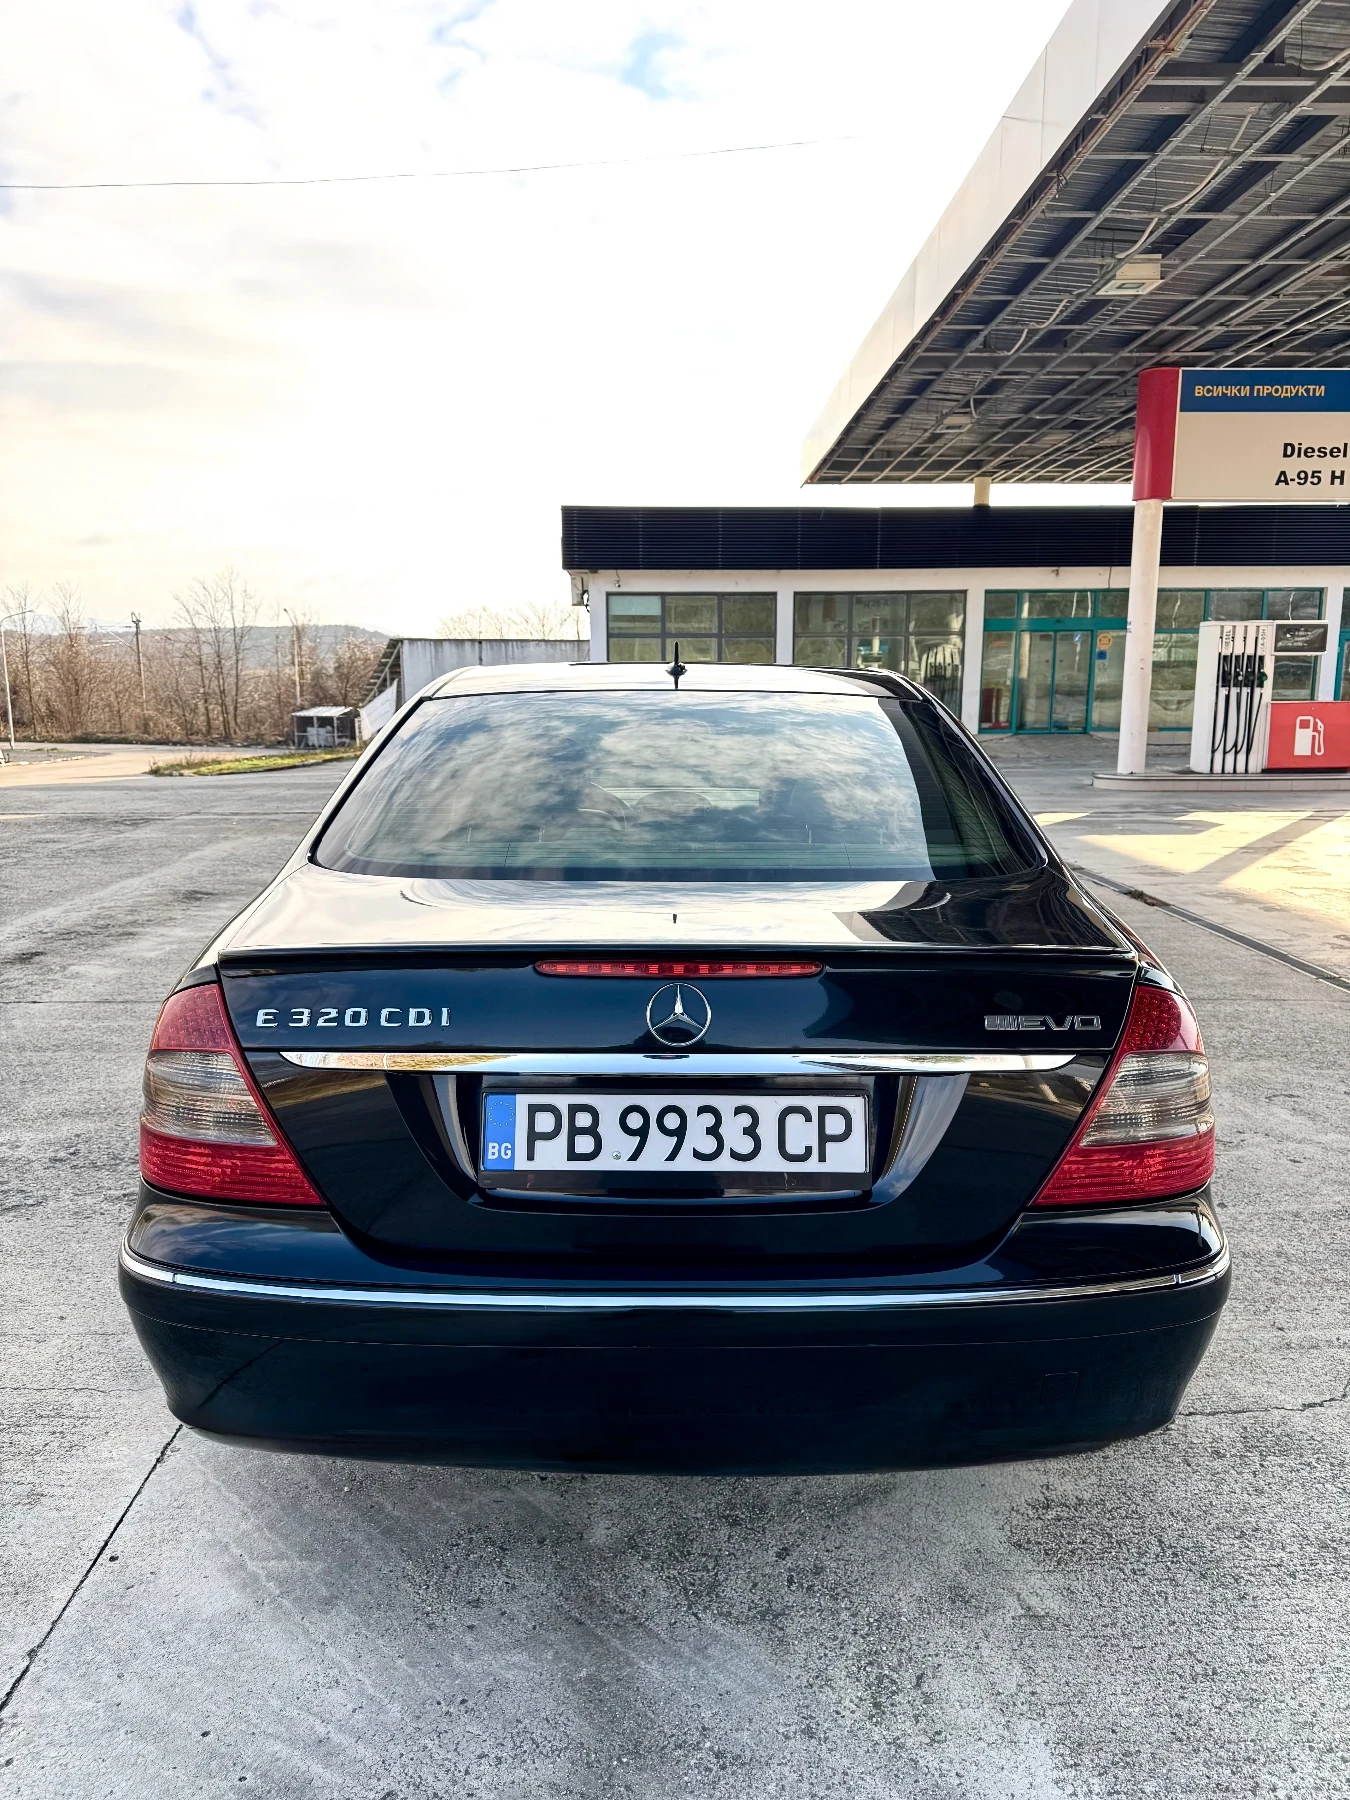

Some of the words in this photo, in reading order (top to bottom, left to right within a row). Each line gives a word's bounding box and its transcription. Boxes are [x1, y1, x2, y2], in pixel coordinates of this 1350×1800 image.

[1194, 385, 1250, 397] ВСИЧКИ
[1253, 385, 1326, 399] ПРОДУКТИ
[1282, 442, 1348, 459] Diesel
[1274, 470, 1322, 486] A-95
[1329, 470, 1346, 486] H
[255, 1007, 280, 1028] E
[288, 1007, 370, 1028] 320
[380, 1007, 451, 1028] CDI
[526, 1103, 603, 1162] PB
[618, 1104, 763, 1162] 9933
[777, 1105, 854, 1163] CP
[487, 1142, 512, 1160] BG
